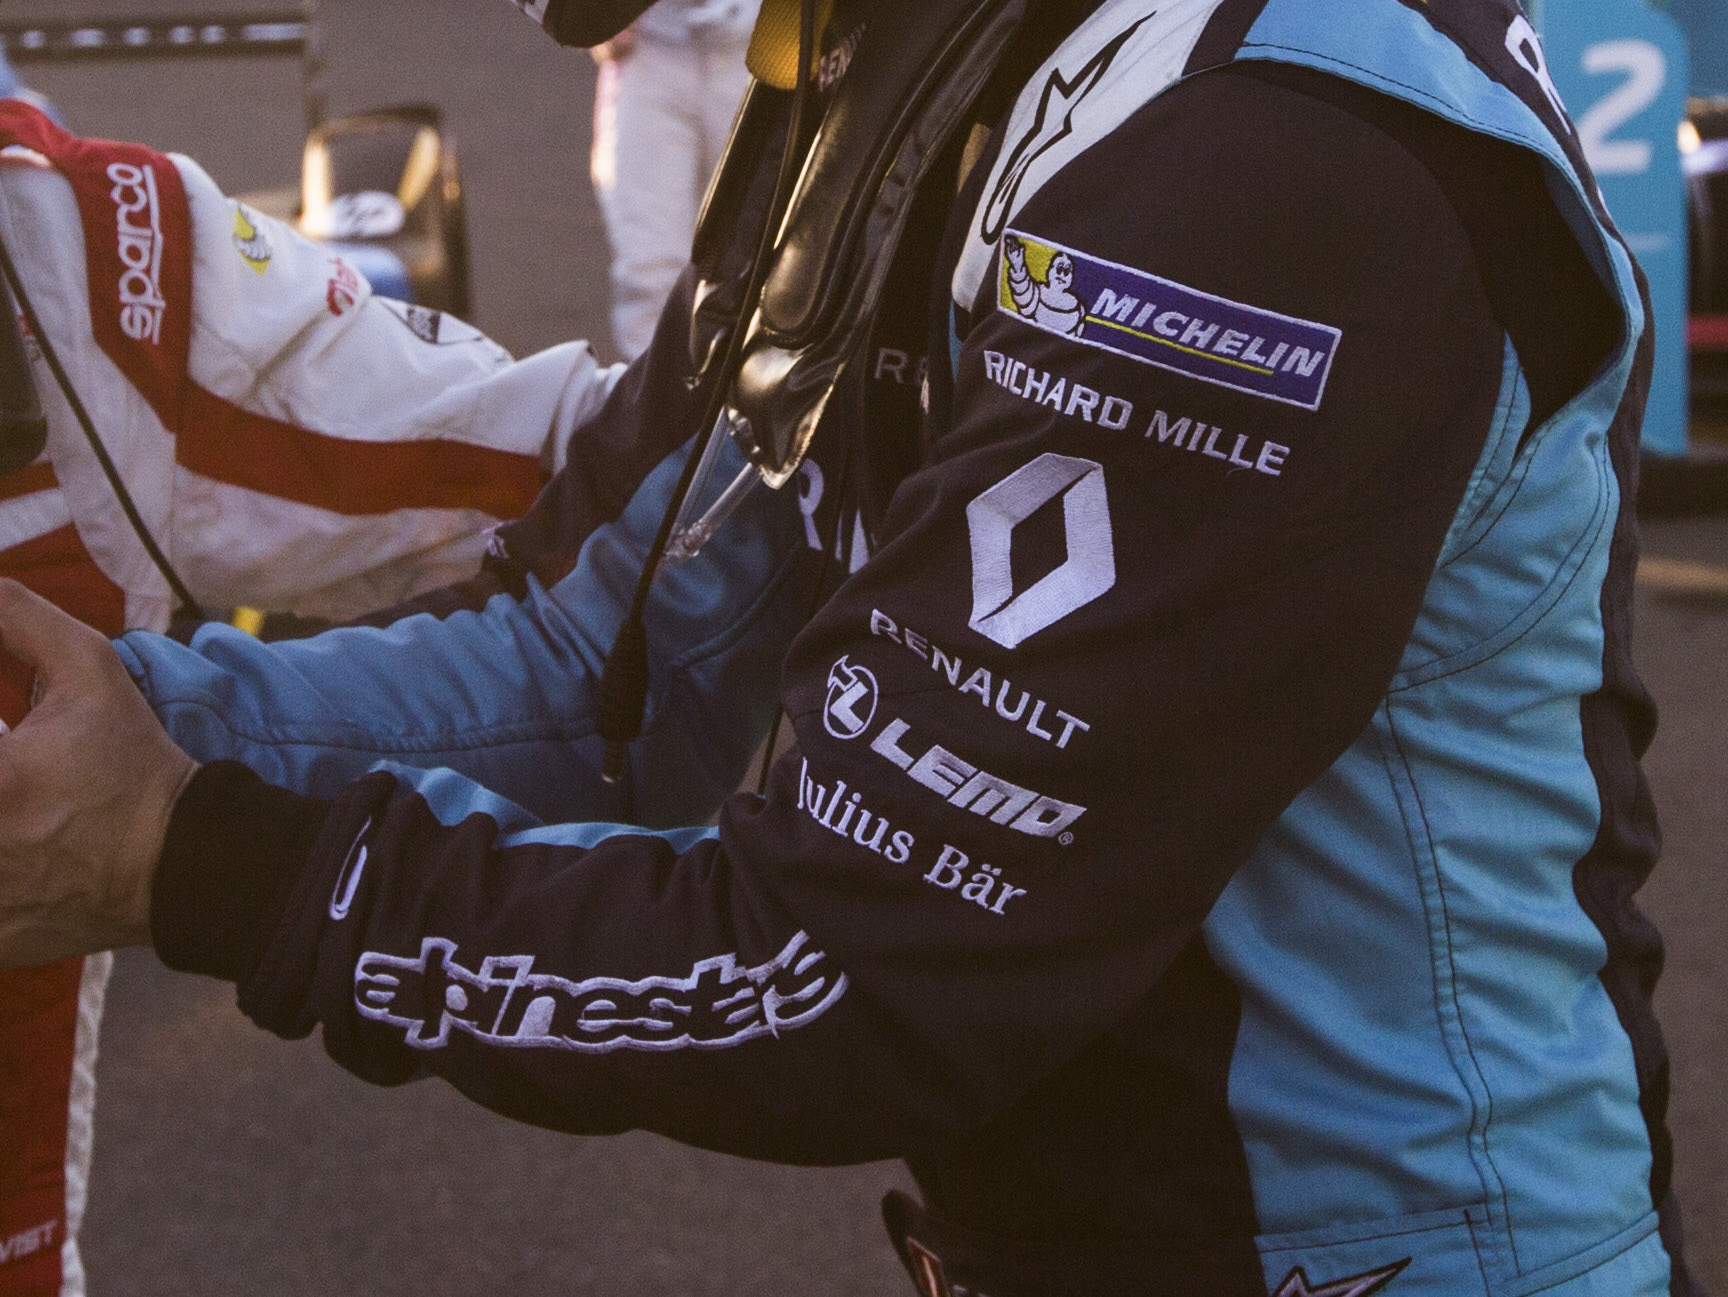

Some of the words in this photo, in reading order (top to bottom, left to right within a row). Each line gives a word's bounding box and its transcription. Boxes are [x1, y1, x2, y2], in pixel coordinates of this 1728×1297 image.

[106, 162, 161, 346] sparco
[1090, 288, 1325, 378] MICHELIN
[983, 350, 1134, 431] RICHARD
[1144, 409, 1290, 477] MILLE
[870, 608, 1091, 749] RENAULT
[796, 755, 915, 865] Julius
[923, 843, 1028, 916] Bär
[870, 717, 1088, 839] LEMO
[354, 929, 850, 1053] alpinestas
